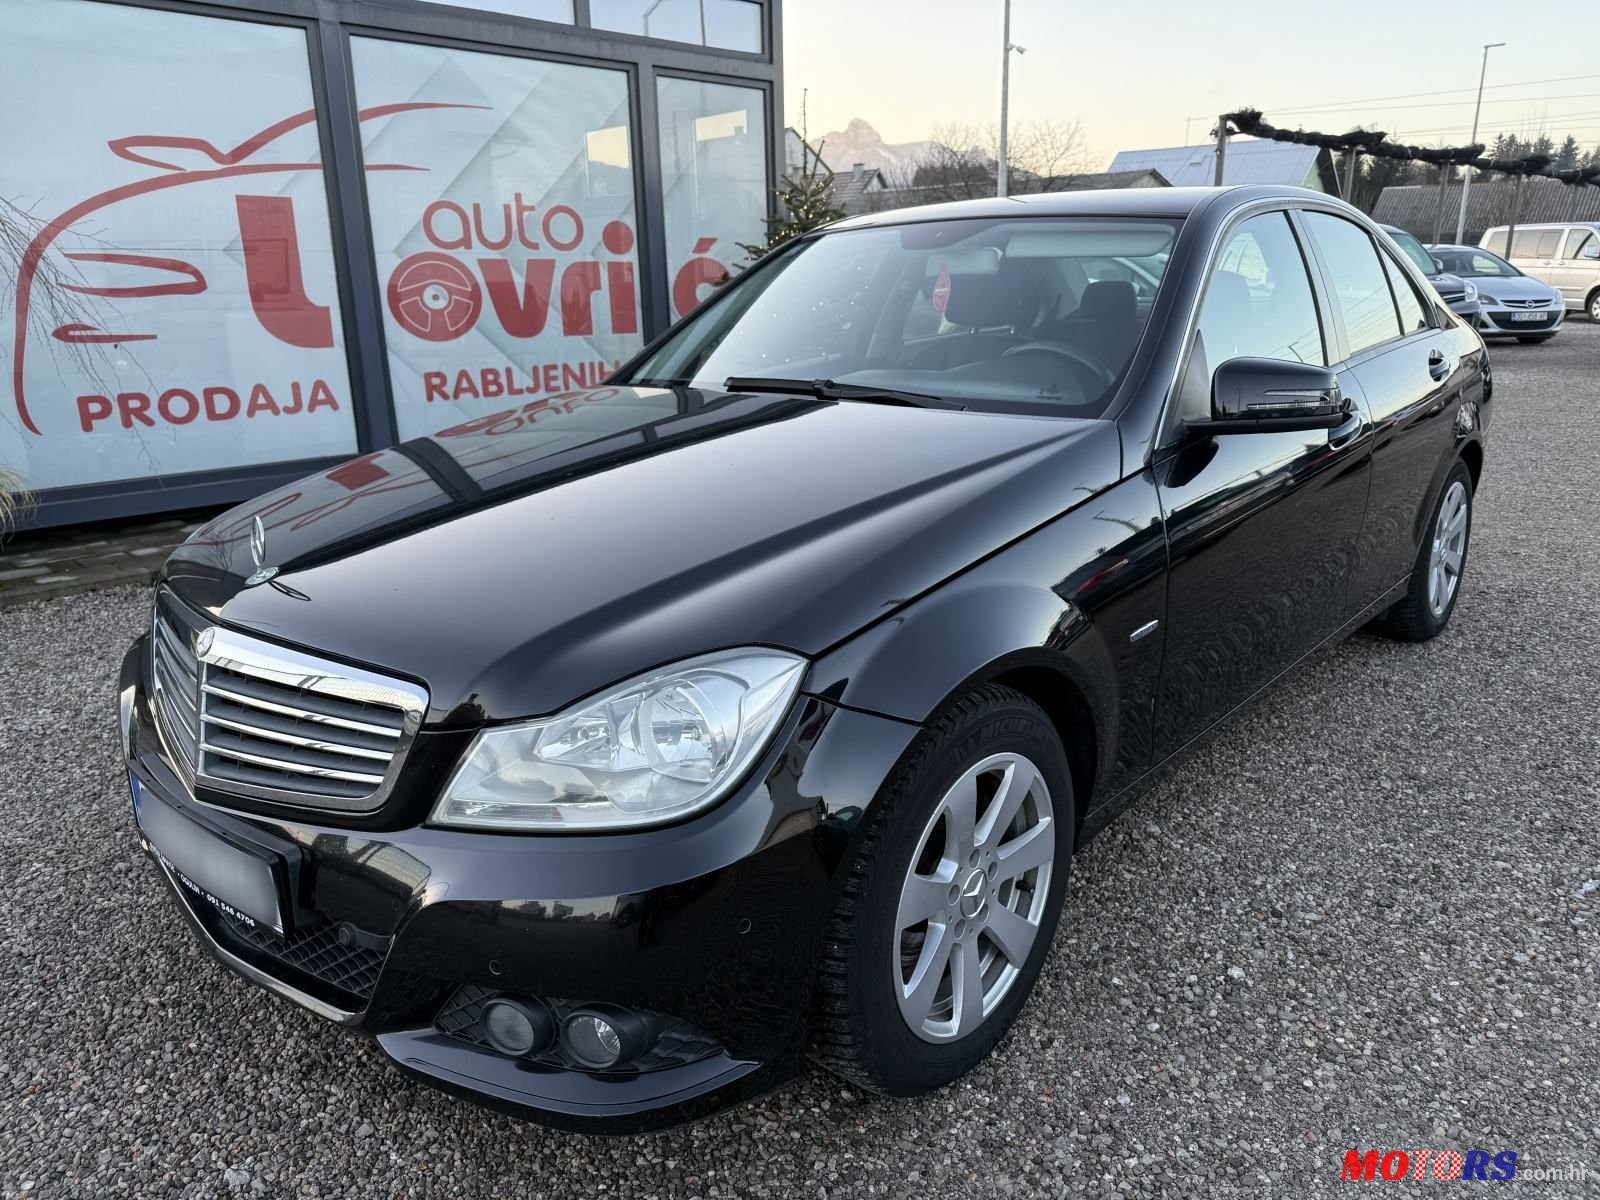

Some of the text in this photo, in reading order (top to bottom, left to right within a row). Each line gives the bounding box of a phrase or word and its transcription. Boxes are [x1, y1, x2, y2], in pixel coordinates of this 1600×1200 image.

[422, 192, 584, 252] auto
[77, 359, 620, 433] PRODAJA RABLJENIH
[206, 894, 219, 906] 091
[221, 903, 234, 915] 546
[236, 912, 255, 927] 4706
